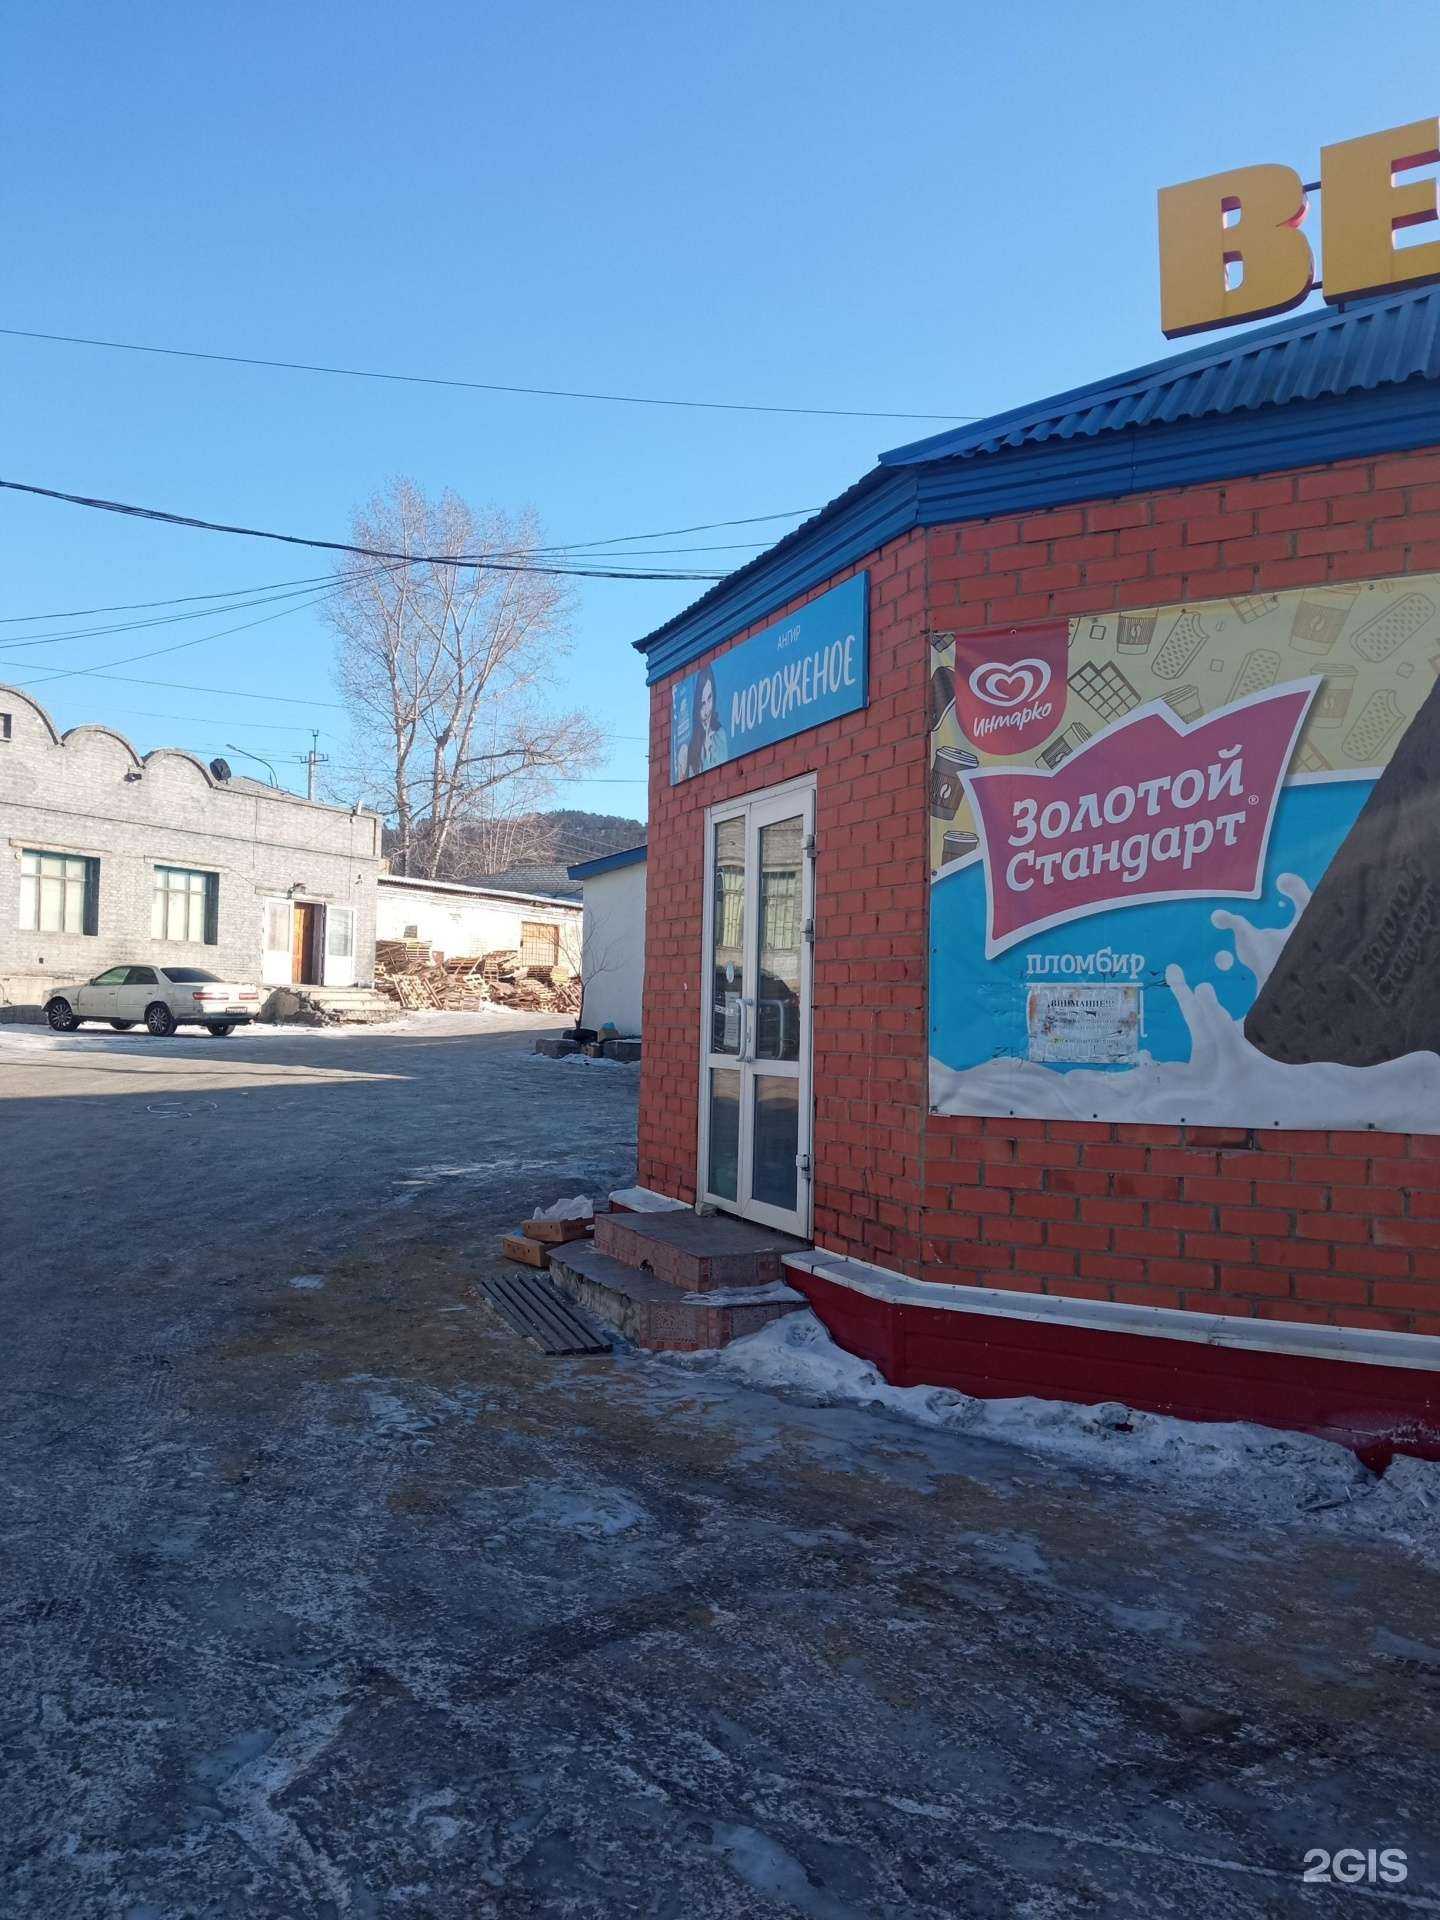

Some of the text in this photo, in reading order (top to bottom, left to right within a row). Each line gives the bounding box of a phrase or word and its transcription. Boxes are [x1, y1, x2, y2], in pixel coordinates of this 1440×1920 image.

[730, 634, 856, 738] МОРОЖЕНОЕ
[1008, 744, 1244, 847] Золотой
[1006, 811, 1246, 892] Стандарт
[1026, 946, 1145, 979] пломбир
